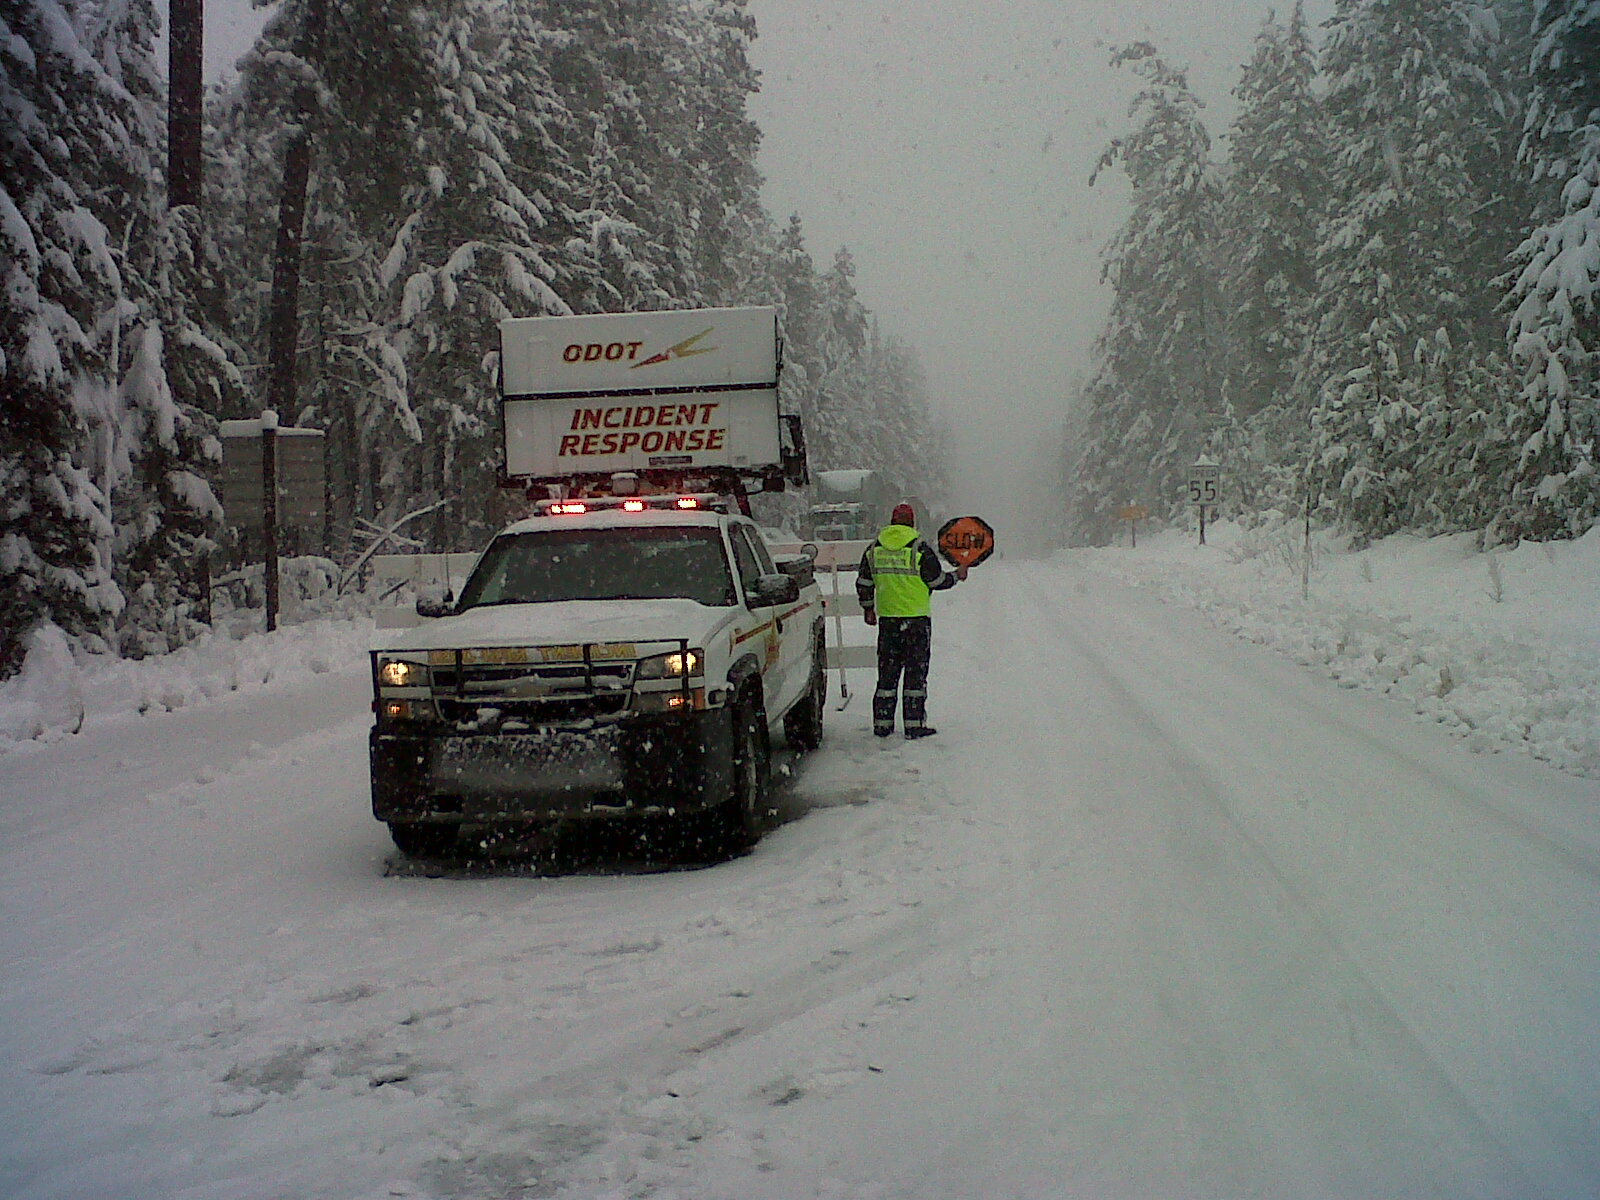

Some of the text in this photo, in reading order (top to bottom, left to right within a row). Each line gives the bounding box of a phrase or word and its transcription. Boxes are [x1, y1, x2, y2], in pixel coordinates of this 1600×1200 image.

[563, 342, 642, 362] ODOT
[570, 403, 719, 430] INCIDENT
[559, 428, 726, 456] RESPONSE
[1190, 480, 1215, 501] 55
[945, 532, 985, 550] SLOW
